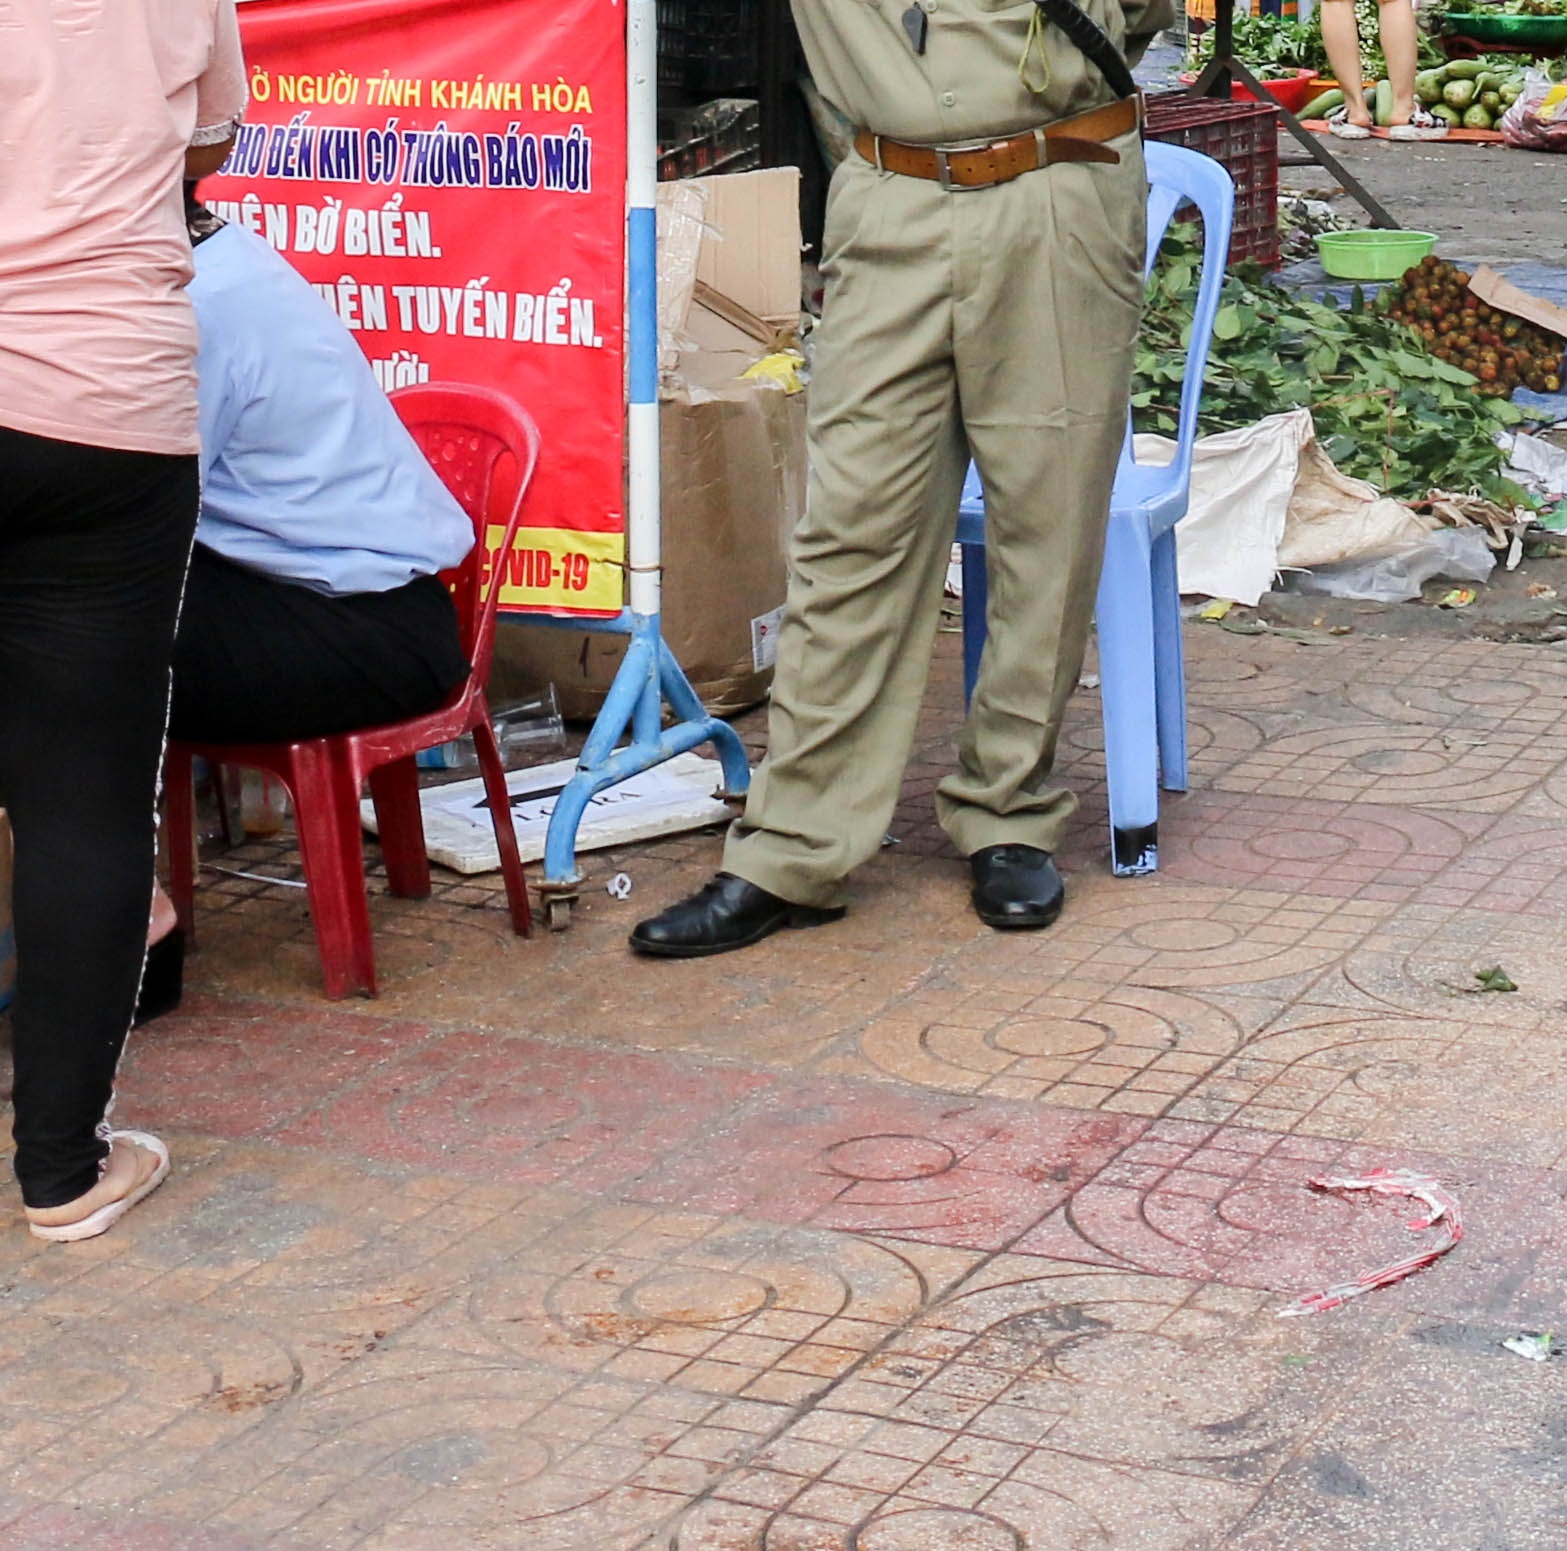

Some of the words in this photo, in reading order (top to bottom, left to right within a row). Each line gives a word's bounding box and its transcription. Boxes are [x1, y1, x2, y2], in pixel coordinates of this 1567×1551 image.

[251, 64, 272, 103] Ở
[278, 70, 360, 107] NGƯỜI
[365, 68, 422, 108] TỈNH
[430, 74, 523, 112] KHÁNH
[531, 76, 594, 114] HÒA
[264, 111, 314, 183] ĐẾN
[318, 124, 361, 183] KHI
[364, 117, 402, 186] CÓ
[400, 122, 483, 189] THÔNG
[484, 121, 540, 190] BÁO
[540, 123, 593, 194] MỚI
[294, 195, 343, 257] BỜ
[344, 191, 442, 258] BIỂN.
[392, 276, 508, 340] TUYẾN
[512, 277, 604, 348] BIỂN.
